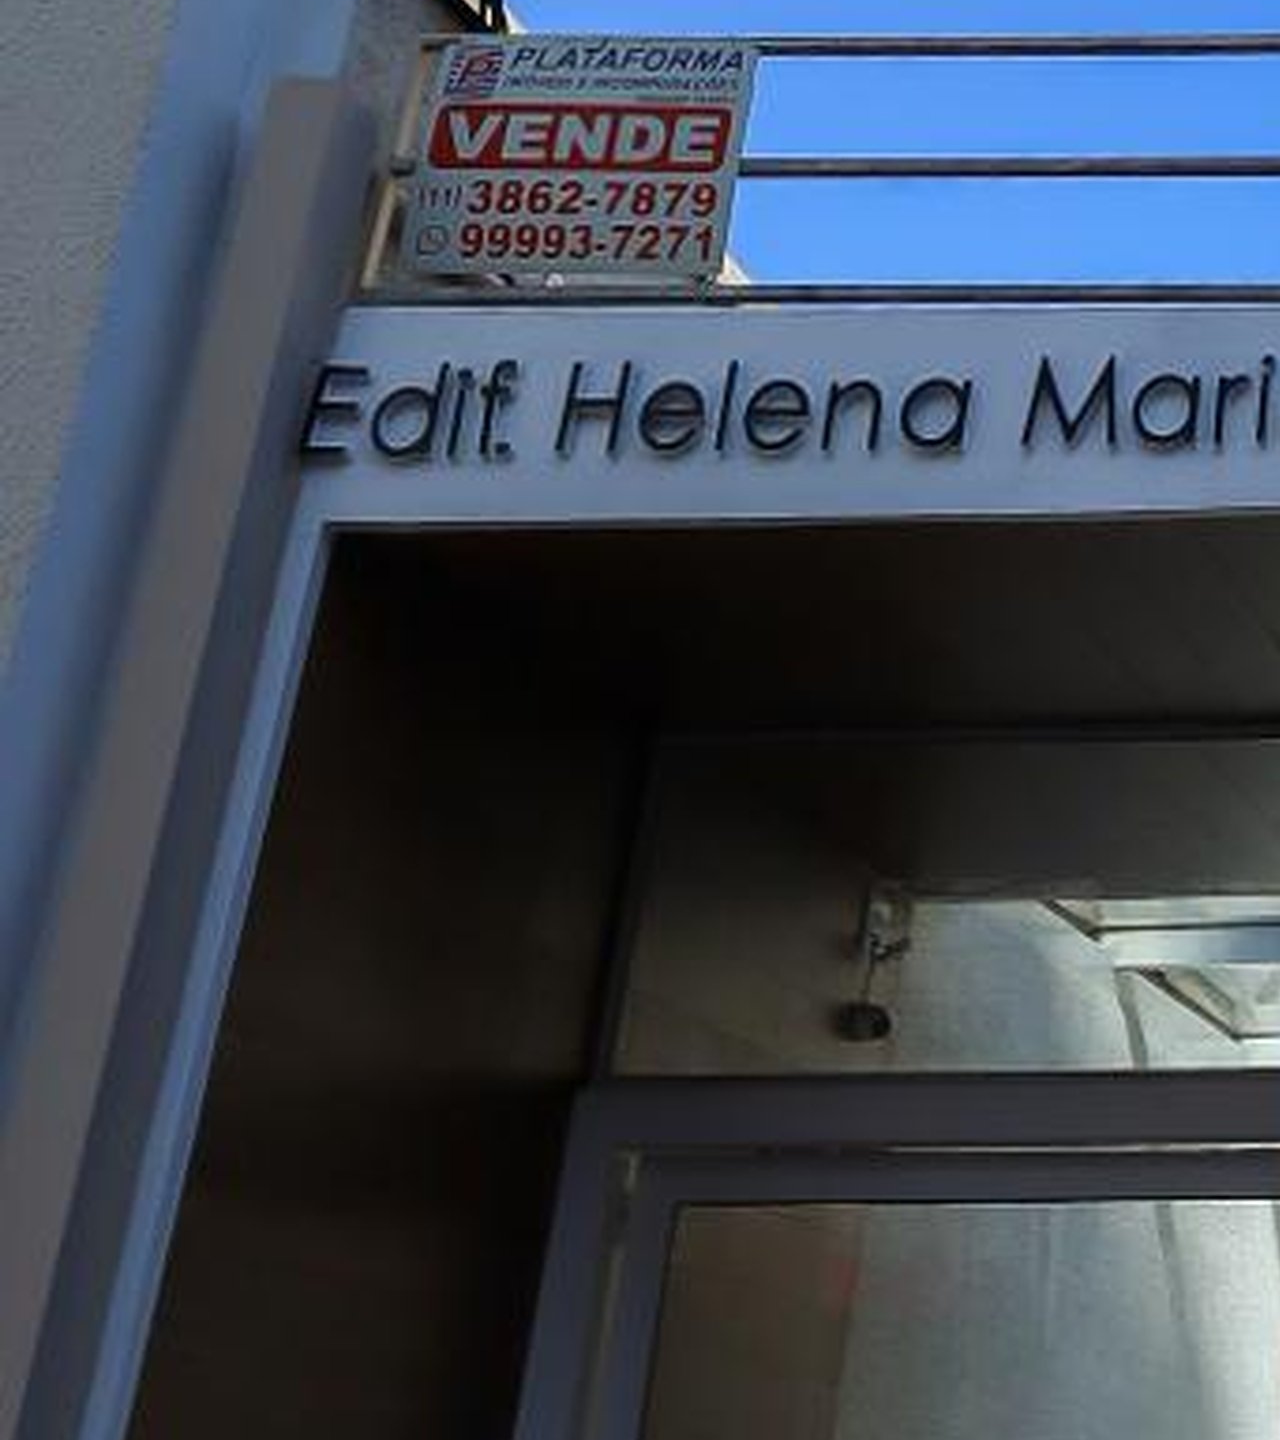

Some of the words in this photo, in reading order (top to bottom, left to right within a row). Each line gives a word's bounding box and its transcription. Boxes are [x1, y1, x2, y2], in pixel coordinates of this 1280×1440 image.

[511, 46, 745, 72] PLATAFORMA
[446, 111, 725, 163] VENDE
[466, 179, 718, 218] 3862-7879
[459, 223, 716, 261] 99993-7271
[301, 359, 518, 462] Edif.
[555, 358, 974, 458] Helena
